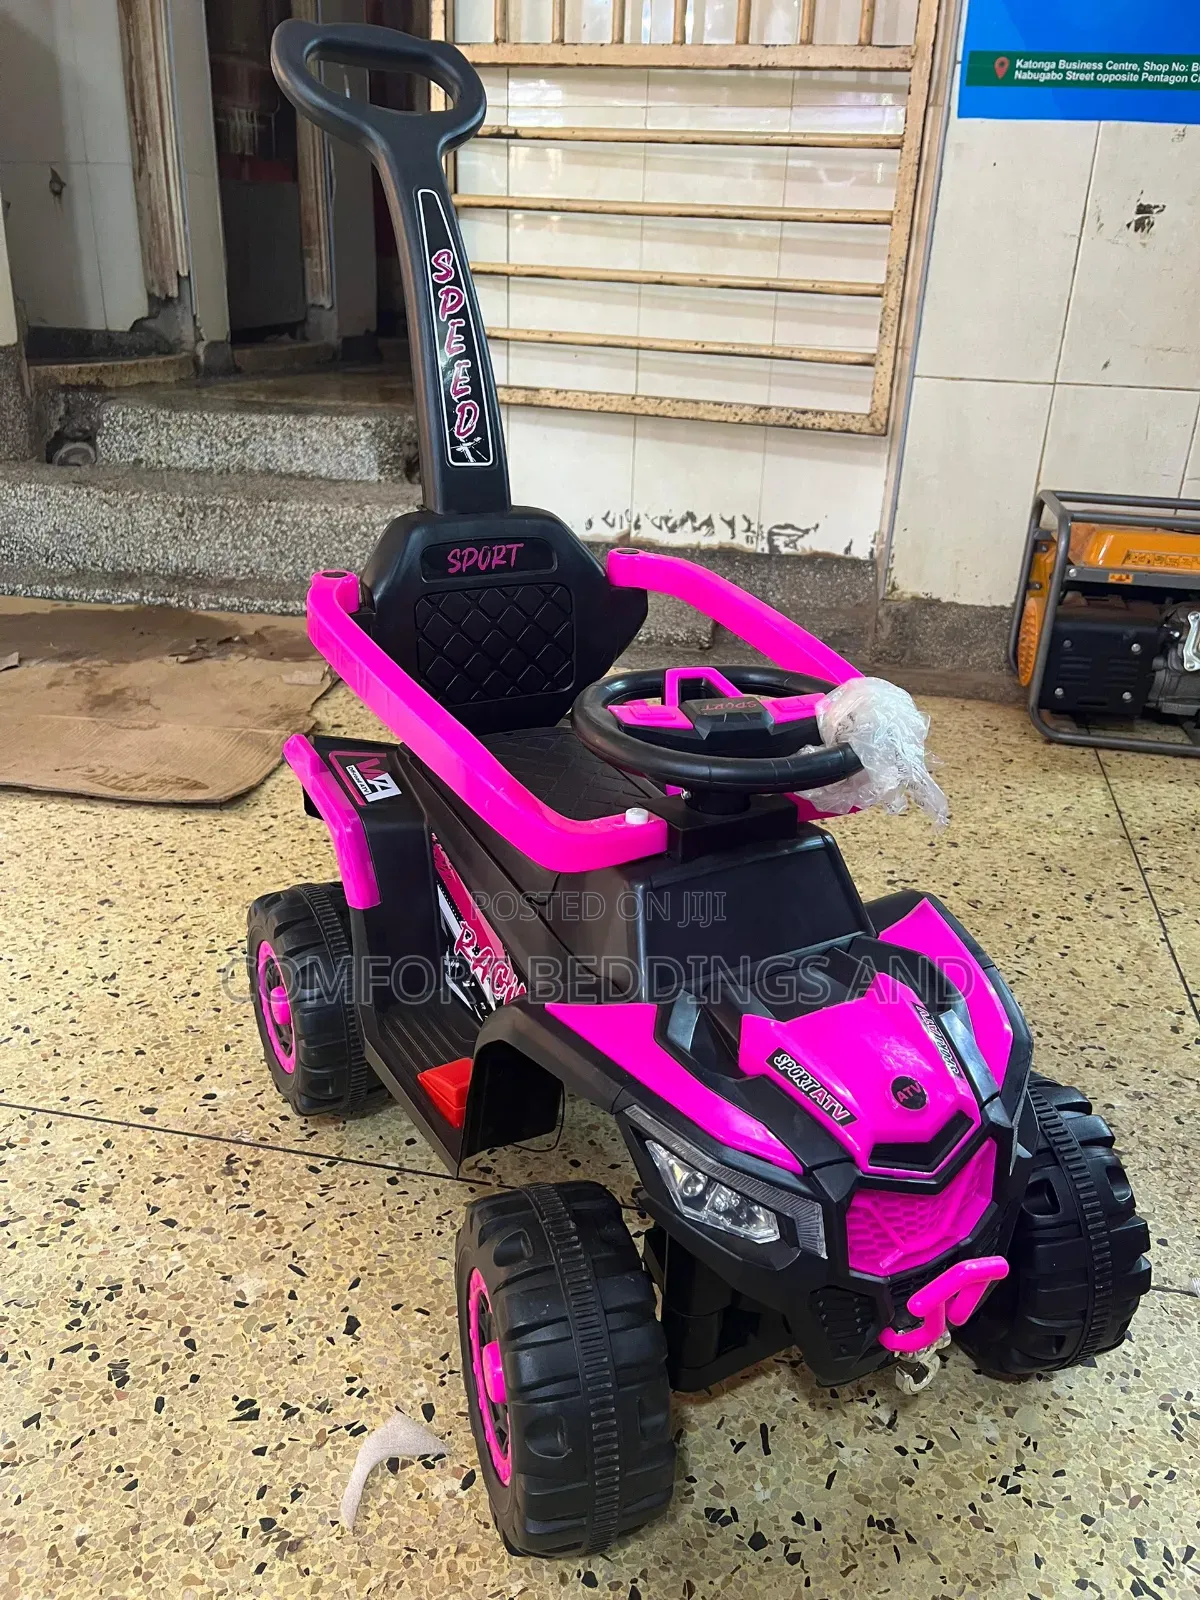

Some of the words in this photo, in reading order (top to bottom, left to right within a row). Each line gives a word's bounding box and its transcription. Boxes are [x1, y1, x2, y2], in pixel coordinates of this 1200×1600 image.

[1014, 70, 1063, 82] Nabugabo
[1065, 70, 1095, 81] Street
[1096, 71, 1139, 83] opposite
[1141, 72, 1188, 84] Pentagon
[1015, 58, 1057, 71] Katonga
[1058, 59, 1103, 70] Business
[1105, 60, 1140, 72] Centre,
[1143, 61, 1169, 73] Shop
[1171, 61, 1188, 72] No:
[1190, 62, 1200, 72] B
[431, 248, 479, 440] SPEED
[446, 542, 525, 575] SPORT
[773, 1053, 819, 1093] SPORT
[811, 1086, 851, 1122] ATV
[896, 1081, 922, 1104] ATV
